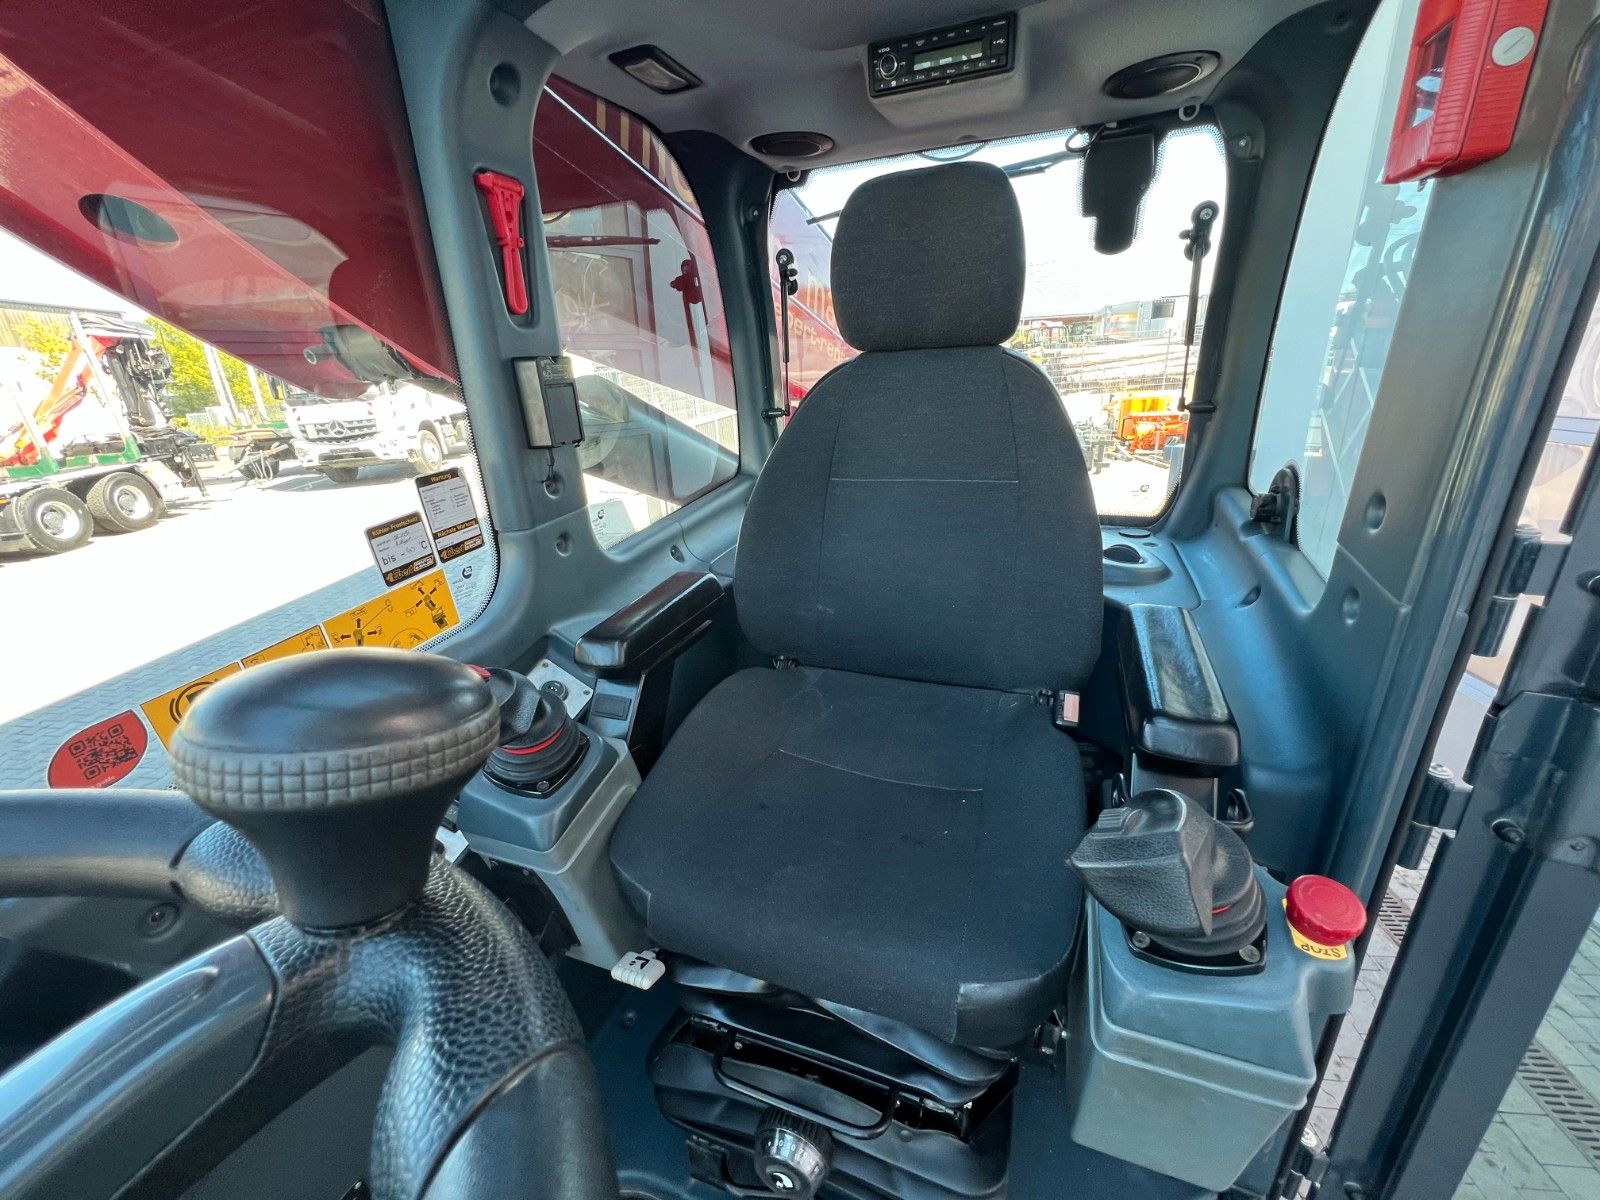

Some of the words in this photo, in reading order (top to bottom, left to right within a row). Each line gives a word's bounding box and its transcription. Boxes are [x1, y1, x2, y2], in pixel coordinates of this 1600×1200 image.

[431, 473, 451, 482] Wartung
[437, 526, 456, 537] Nächste
[456, 520, 475, 532] Wartung
[382, 554, 396, 565] bis
[1300, 943, 1342, 958] STOP
